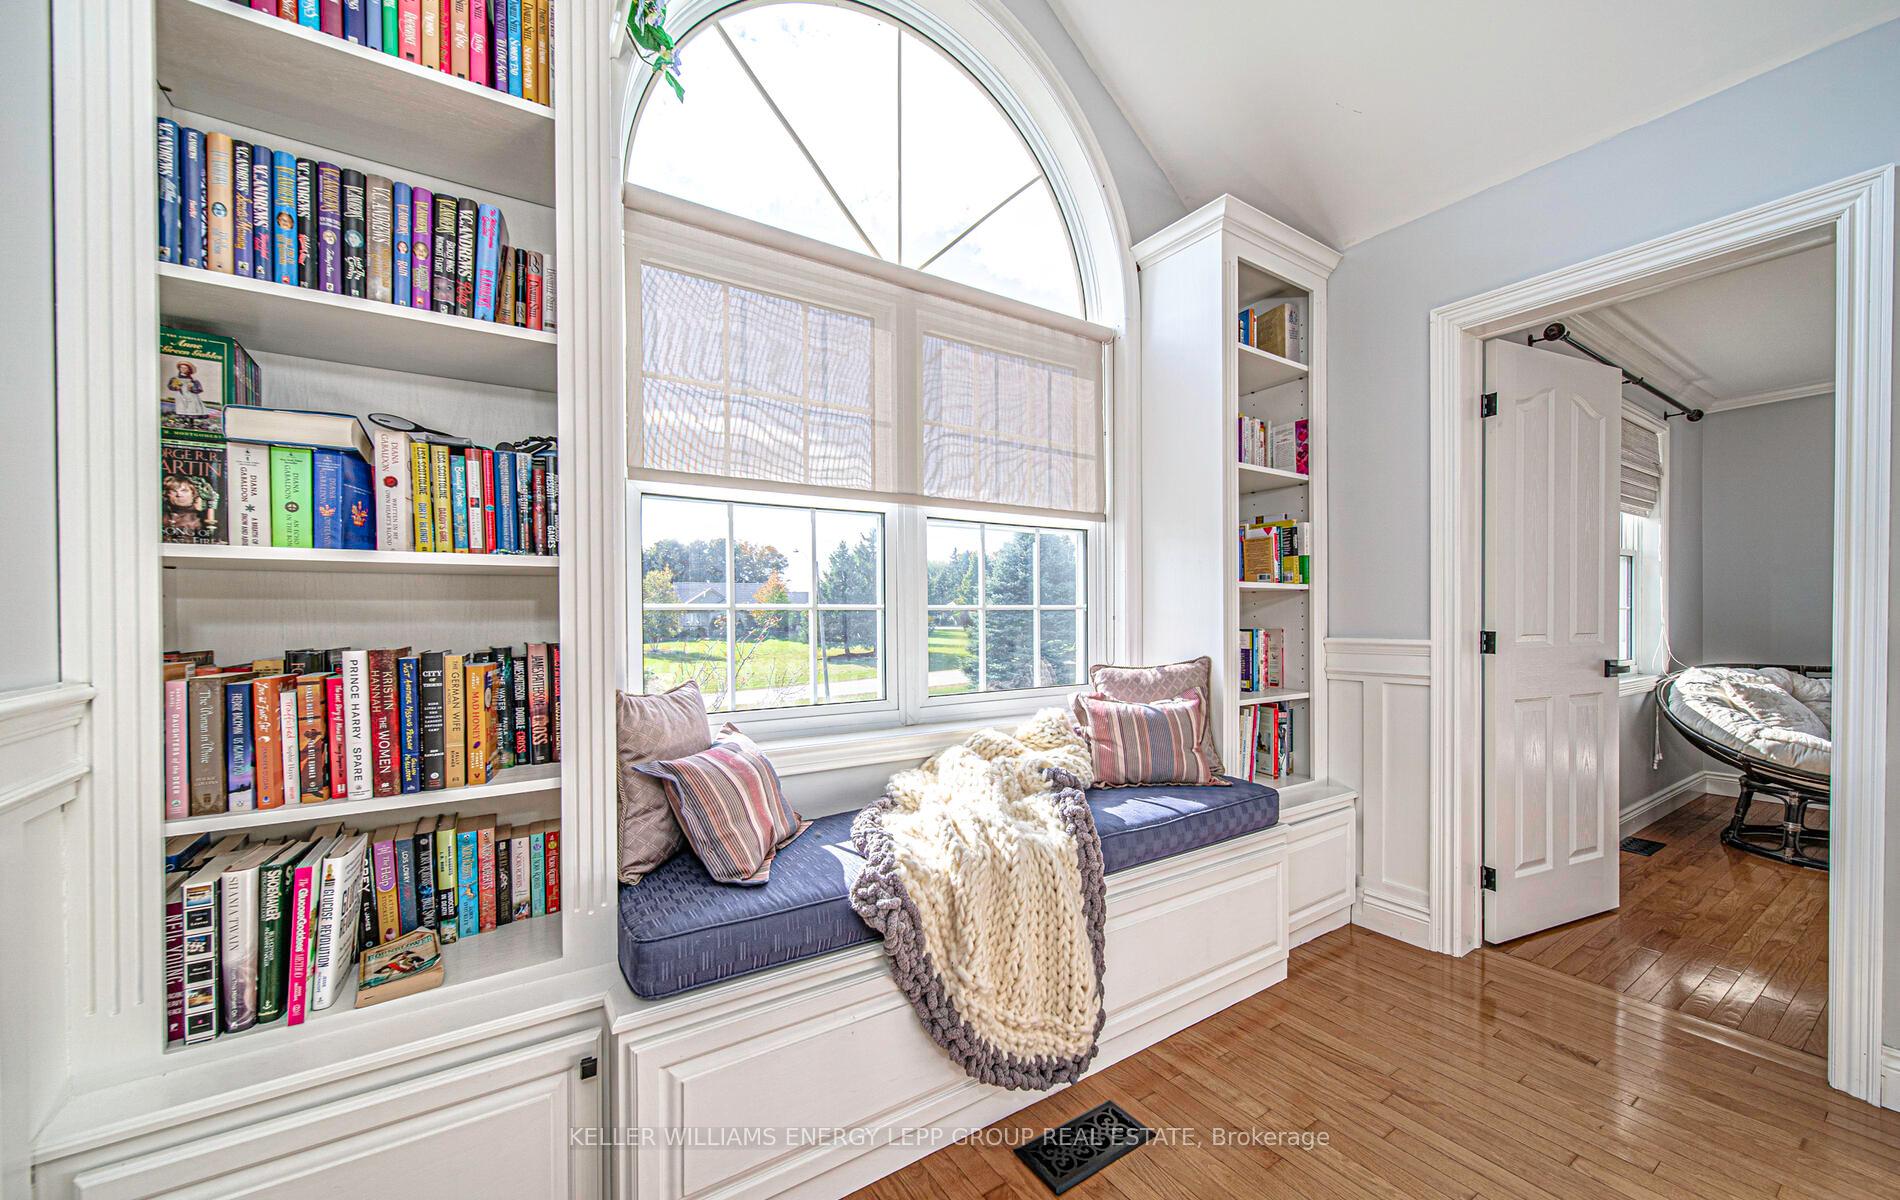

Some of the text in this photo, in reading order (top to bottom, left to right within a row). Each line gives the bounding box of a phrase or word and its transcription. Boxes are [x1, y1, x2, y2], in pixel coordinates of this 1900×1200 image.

[524, 24, 534, 40] STEEL
[434, 257, 444, 273] FLIGHT
[456, 279, 473, 307] Ruby
[170, 340, 203, 349] Anne
[381, 434, 390, 472] GABALDON
[162, 460, 222, 477] ARTIN
[417, 447, 428, 495] LISA SCOTTOLINE
[437, 451, 448, 499] LISA SCOTTOLINE
[418, 502, 428, 544] DIRTY BLONDE
[438, 508, 449, 543] DADDY'S GIRL
[403, 663, 413, 677] JUST
[199, 690, 211, 706] The
[232, 693, 242, 711] FREDRIK
[371, 670, 381, 713] HANNAH
[383, 671, 393, 710] KRISTIN
[405, 679, 414, 705] ANOTHER
[451, 672, 460, 709] GERMAN
[497, 688, 506, 711] WATER
[199, 706, 214, 733] Woman
[232, 712, 243, 734] BACKMAN
[285, 698, 295, 740] Trafficked
[350, 659, 363, 781] PRINCE HARRY SPARE
[405, 705, 414, 727] MISSING
[452, 711, 461, 732] WIFE
[171, 714, 180, 756] DAUGHTERS
[516, 707, 526, 753] DOUBLE CROSS
[531, 715, 548, 746] CROSS
[201, 743, 215, 764] White
[234, 745, 244, 764] AGAINST
[379, 730, 391, 774] WOMEN
[233, 765, 243, 776] YOU
[482, 843, 493, 861] NORA
[379, 867, 392, 886] Help
[483, 862, 493, 889] ROBERTS
[265, 869, 282, 921] SHOEMAKER
[165, 914, 183, 942] NEIL
[229, 877, 239, 952] SHANIA TWAIN
[318, 889, 334, 968] GLUCOSE REVOLUTION
